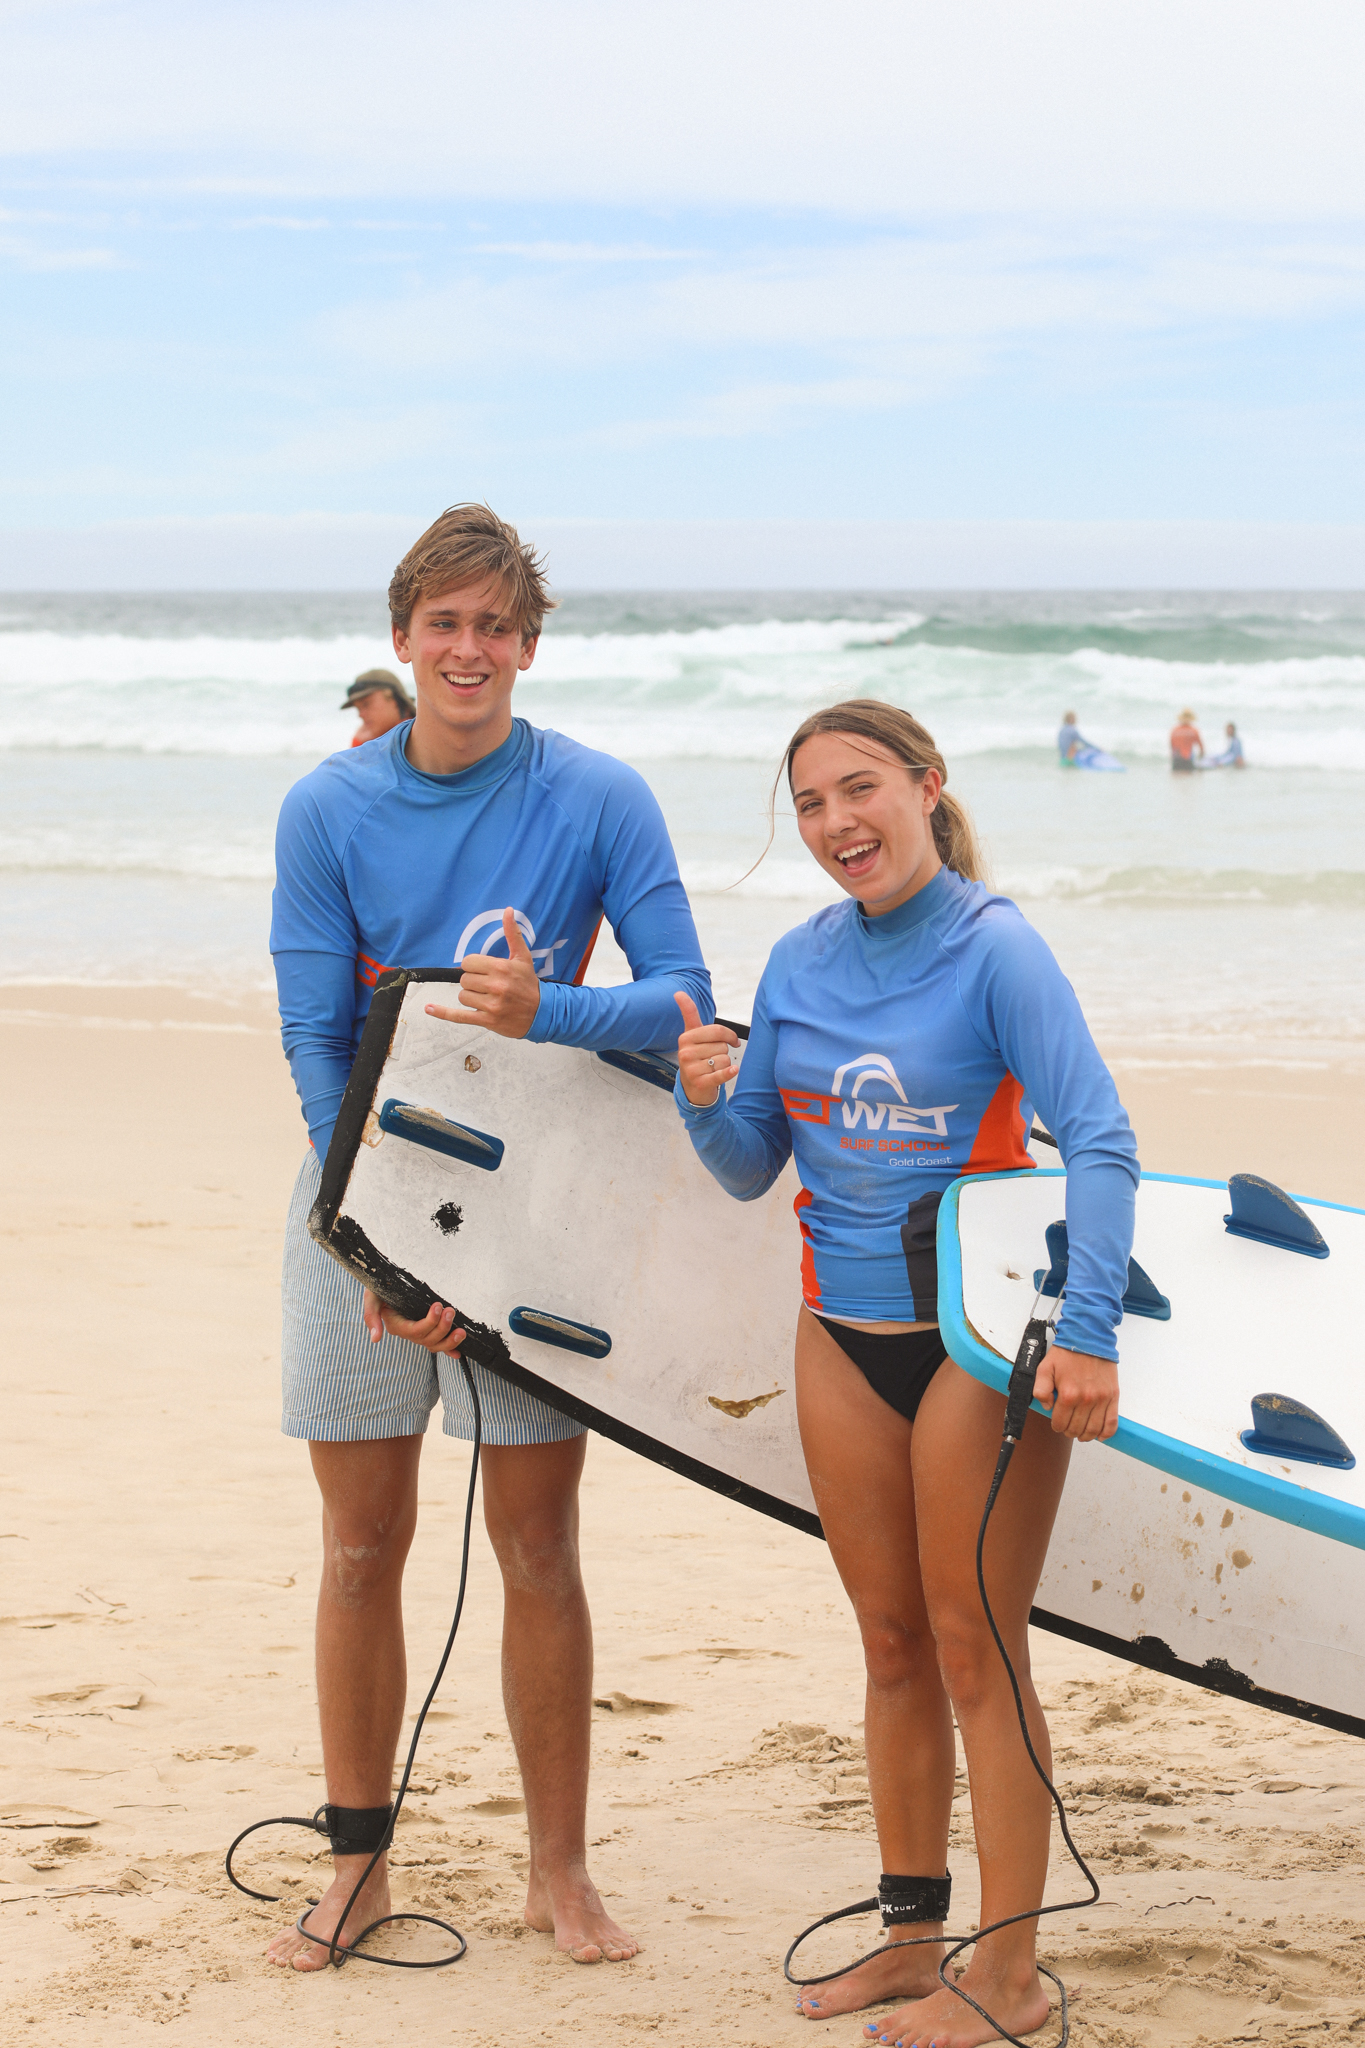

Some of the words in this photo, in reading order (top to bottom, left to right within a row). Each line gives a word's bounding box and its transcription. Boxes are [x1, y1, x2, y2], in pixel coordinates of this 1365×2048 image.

[777, 1086, 843, 1126] ET
[841, 1100, 960, 1136] WET
[840, 1137, 875, 1151] SURF
[878, 1140, 951, 1152] SCHOOL
[889, 1158, 914, 1167] Gold
[917, 1156, 953, 1166] Coast
